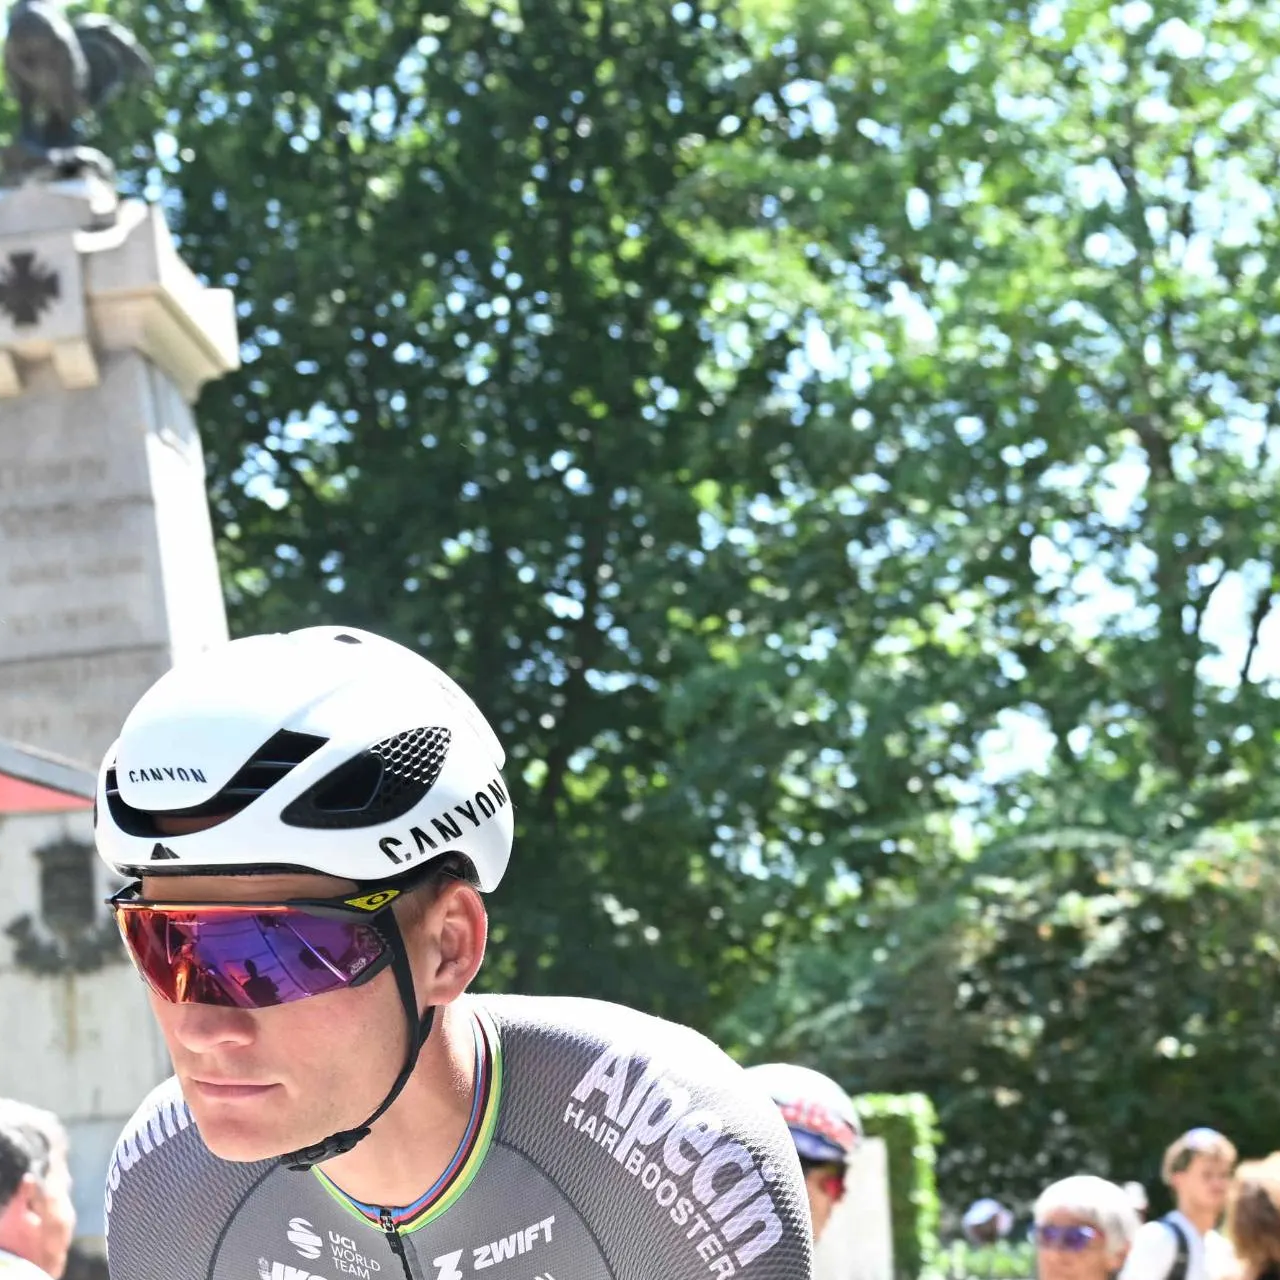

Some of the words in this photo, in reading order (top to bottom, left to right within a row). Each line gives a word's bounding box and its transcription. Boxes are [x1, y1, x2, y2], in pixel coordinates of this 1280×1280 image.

[128, 767, 208, 783] CANYON
[378, 779, 508, 865] CANYON
[563, 1102, 620, 1158] HAIR
[571, 1048, 784, 1268] Alpecin
[328, 1230, 358, 1252] UCI
[331, 1244, 381, 1272] WORLD
[472, 1215, 556, 1271] ZWIFT
[331, 1256, 371, 1280] TEAM
